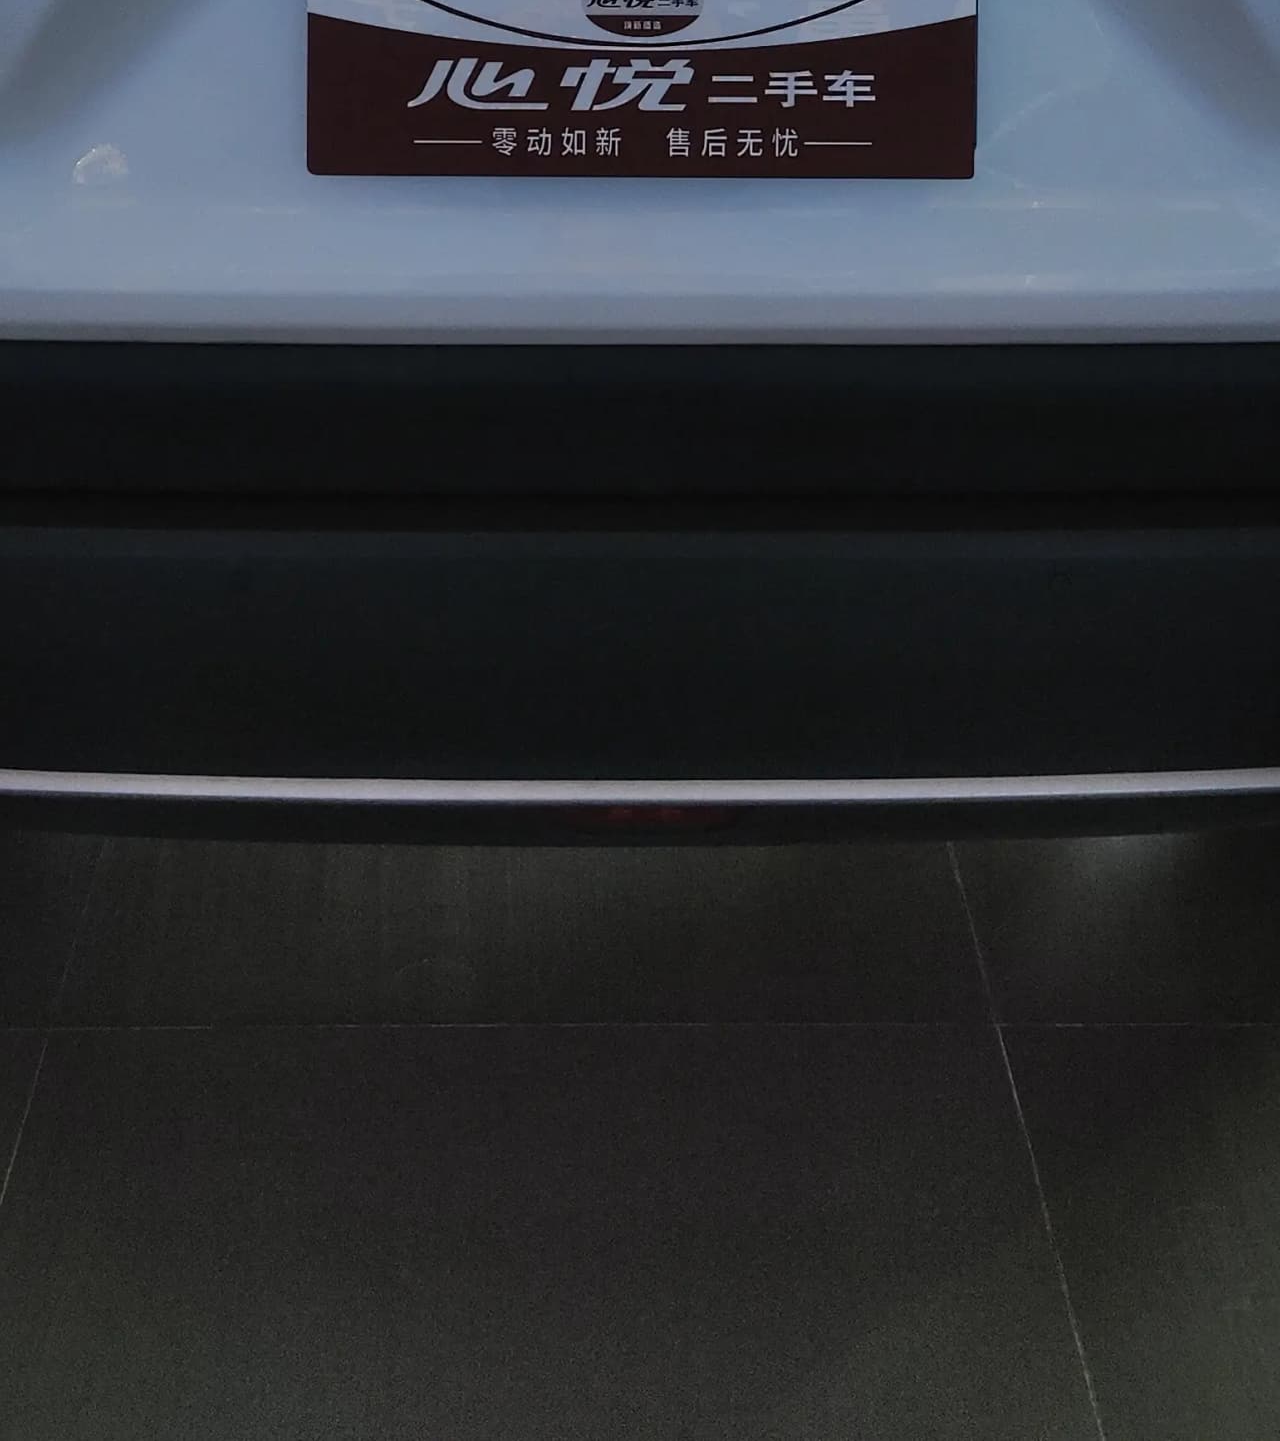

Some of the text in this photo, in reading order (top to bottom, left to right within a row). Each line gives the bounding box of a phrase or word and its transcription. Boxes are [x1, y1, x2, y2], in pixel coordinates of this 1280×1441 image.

[406, 58, 877, 112] 心悦二手车
[491, 127, 799, 158] 零动如新 售后无忧
